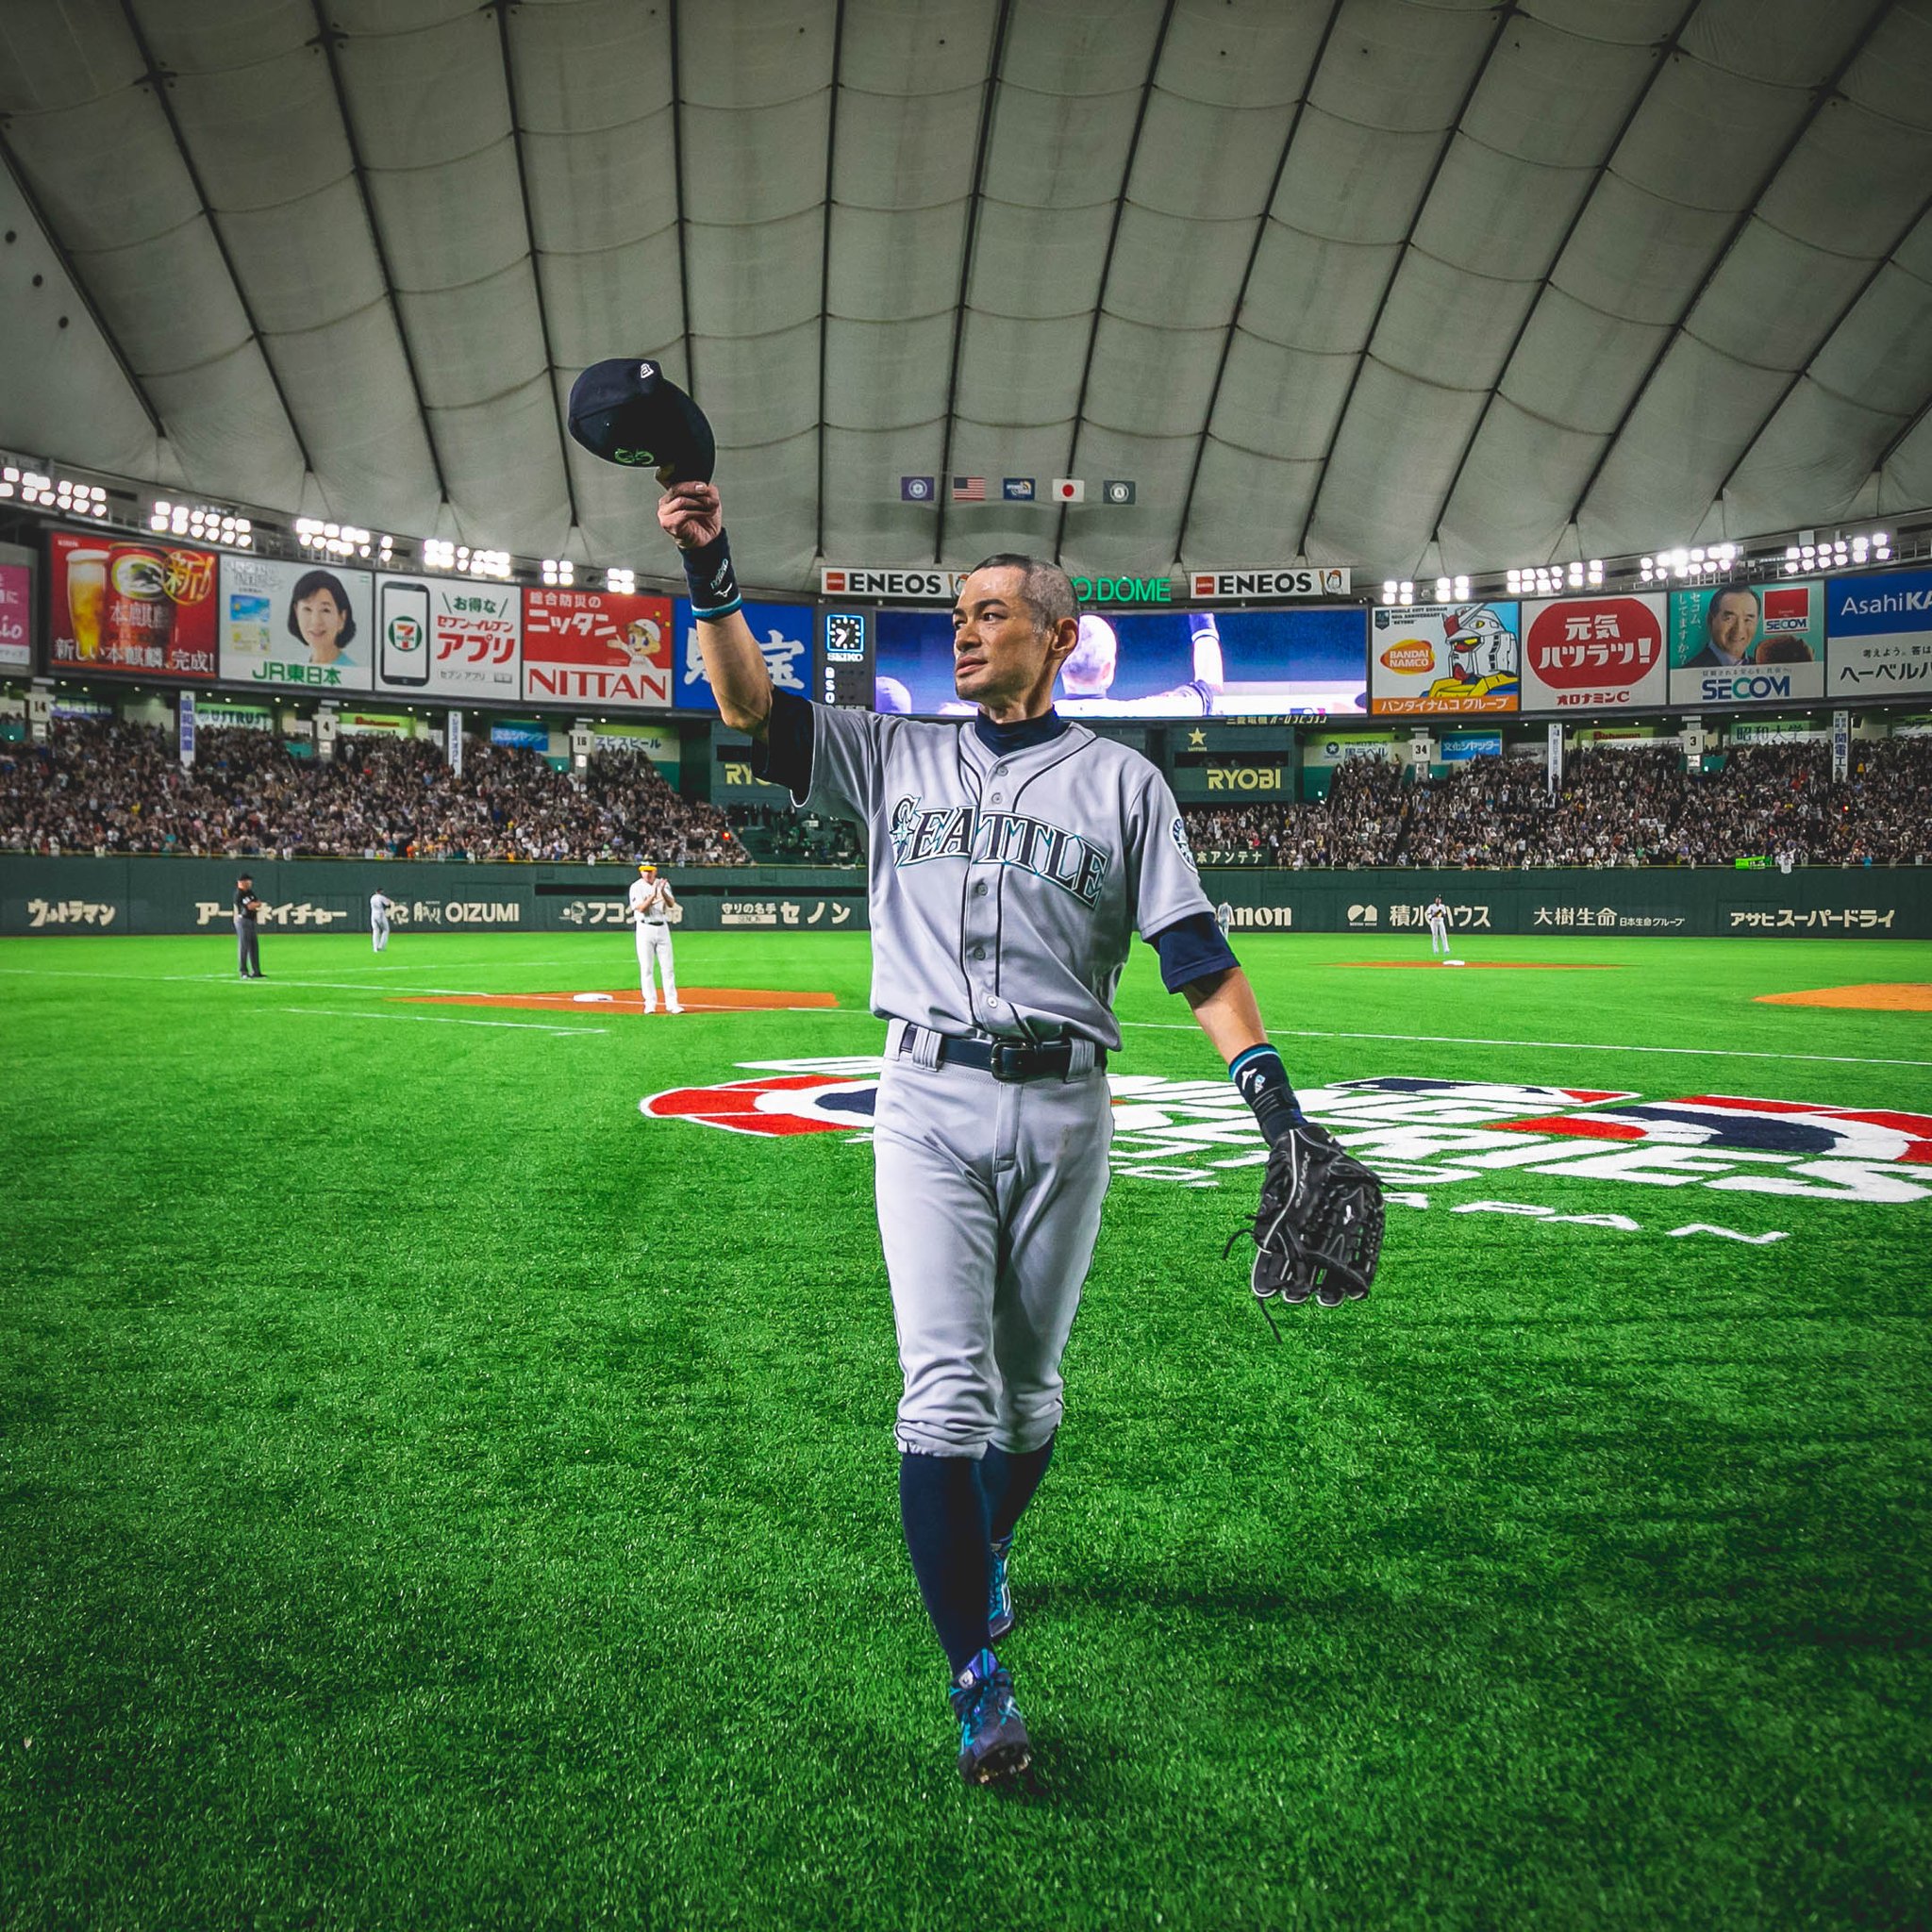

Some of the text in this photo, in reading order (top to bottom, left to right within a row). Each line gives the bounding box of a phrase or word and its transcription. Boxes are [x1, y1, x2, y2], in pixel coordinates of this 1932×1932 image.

[849, 573, 941, 595] ENEOS
[1097, 577, 1172, 603] DOME
[1218, 573, 1312, 595] ENEOS
[454, 596, 497, 613] お得な
[527, 608, 617, 637] ニッタン
[1565, 614, 1621, 641] 元気
[1766, 619, 1807, 631] SECOM
[437, 633, 515, 664] アプリ
[826, 653, 864, 662] SEIKO
[1390, 649, 1429, 659] BANDAI
[252, 661, 342, 686] JR東日本
[1390, 658, 1429, 668] NAMCO
[529, 668, 666, 701] NITTAN
[1702, 675, 1790, 700] SECOM
[1557, 691, 1630, 706] オロナミンC
[1737, 724, 1804, 741] 昭和大学
[1415, 743, 1427, 754] 34
[1207, 769, 1281, 790] RYOBI
[891, 794, 1110, 910] SEATTLE
[1196, 851, 1262, 864] 本アンテナ
[195, 902, 347, 924] アーネイチャー
[445, 902, 520, 923] OIZUMI
[722, 903, 776, 914] 守りの名手
[780, 901, 851, 924] セノン
[1534, 908, 1618, 926] 大樹生命
[1730, 909, 1895, 928] アサヒスーパードライ
